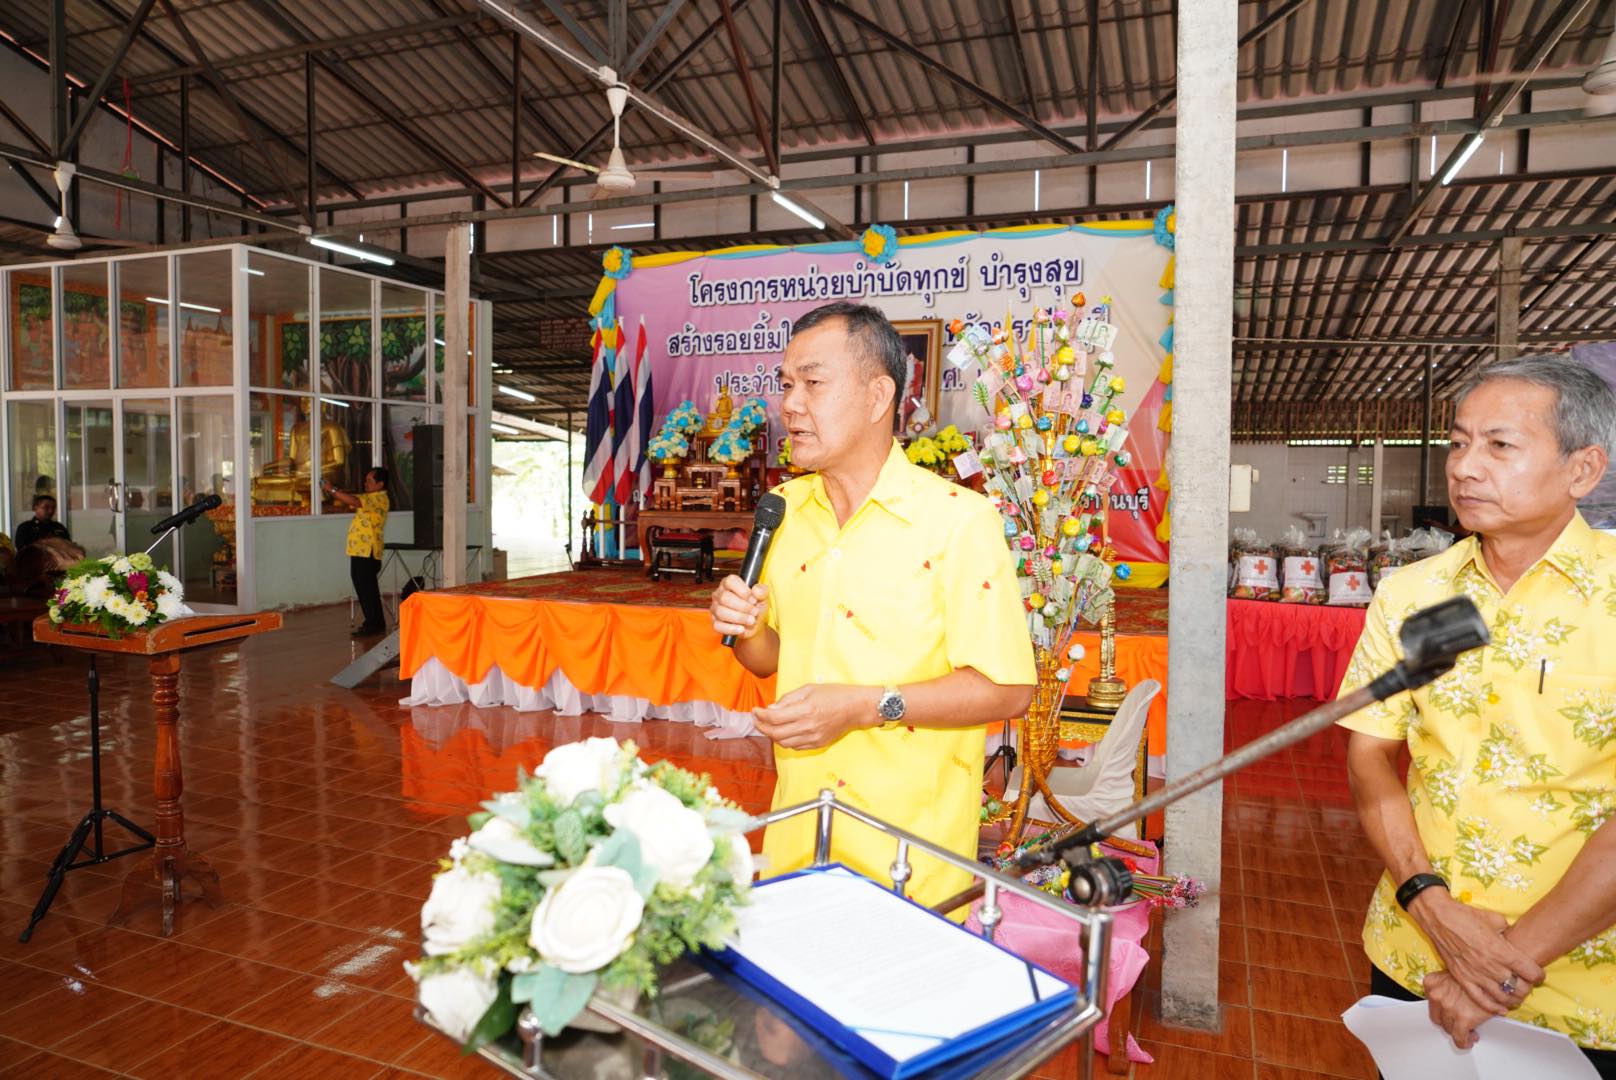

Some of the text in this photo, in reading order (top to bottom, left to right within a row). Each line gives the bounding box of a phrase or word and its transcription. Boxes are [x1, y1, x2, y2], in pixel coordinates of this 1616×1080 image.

[689, 252, 1080, 304] โครงการหน่วยบำบัดทุกข์ บำรุงสุข
[668, 312, 793, 354] สร้างรอยยิ้มใ
